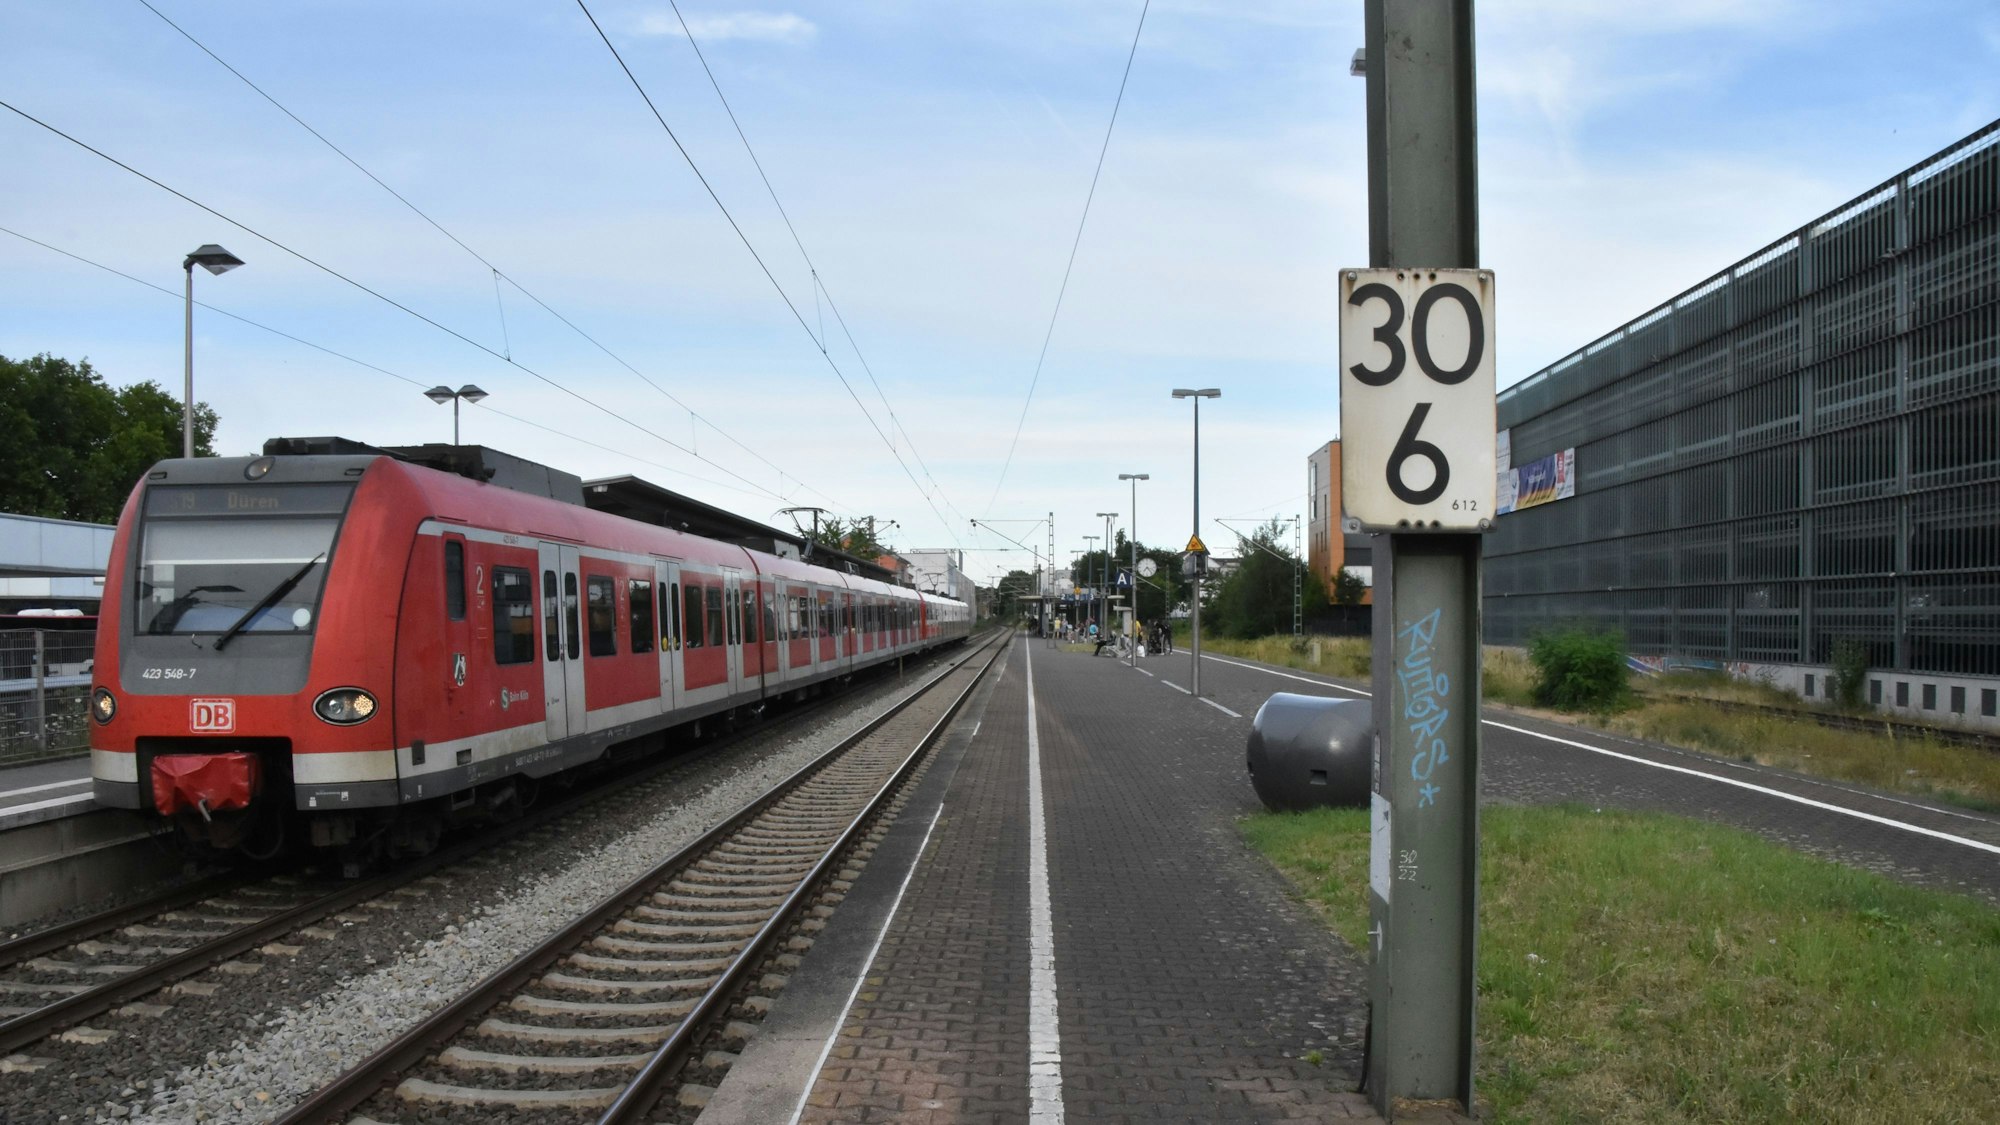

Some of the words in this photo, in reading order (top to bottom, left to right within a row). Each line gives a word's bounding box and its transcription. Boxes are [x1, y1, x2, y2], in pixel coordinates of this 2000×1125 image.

[1348, 283, 1485, 387] 30
[1385, 402, 1451, 506] 6
[227, 491, 280, 510] Düren
[1451, 499, 1478, 512] 612
[476, 565, 484, 595] 2
[1117, 572, 1127, 585] A
[142, 668, 162, 680] 423
[164, 668, 197, 680] 548-7
[196, 704, 230, 727] DB
[1398, 869, 1417, 882] 22
